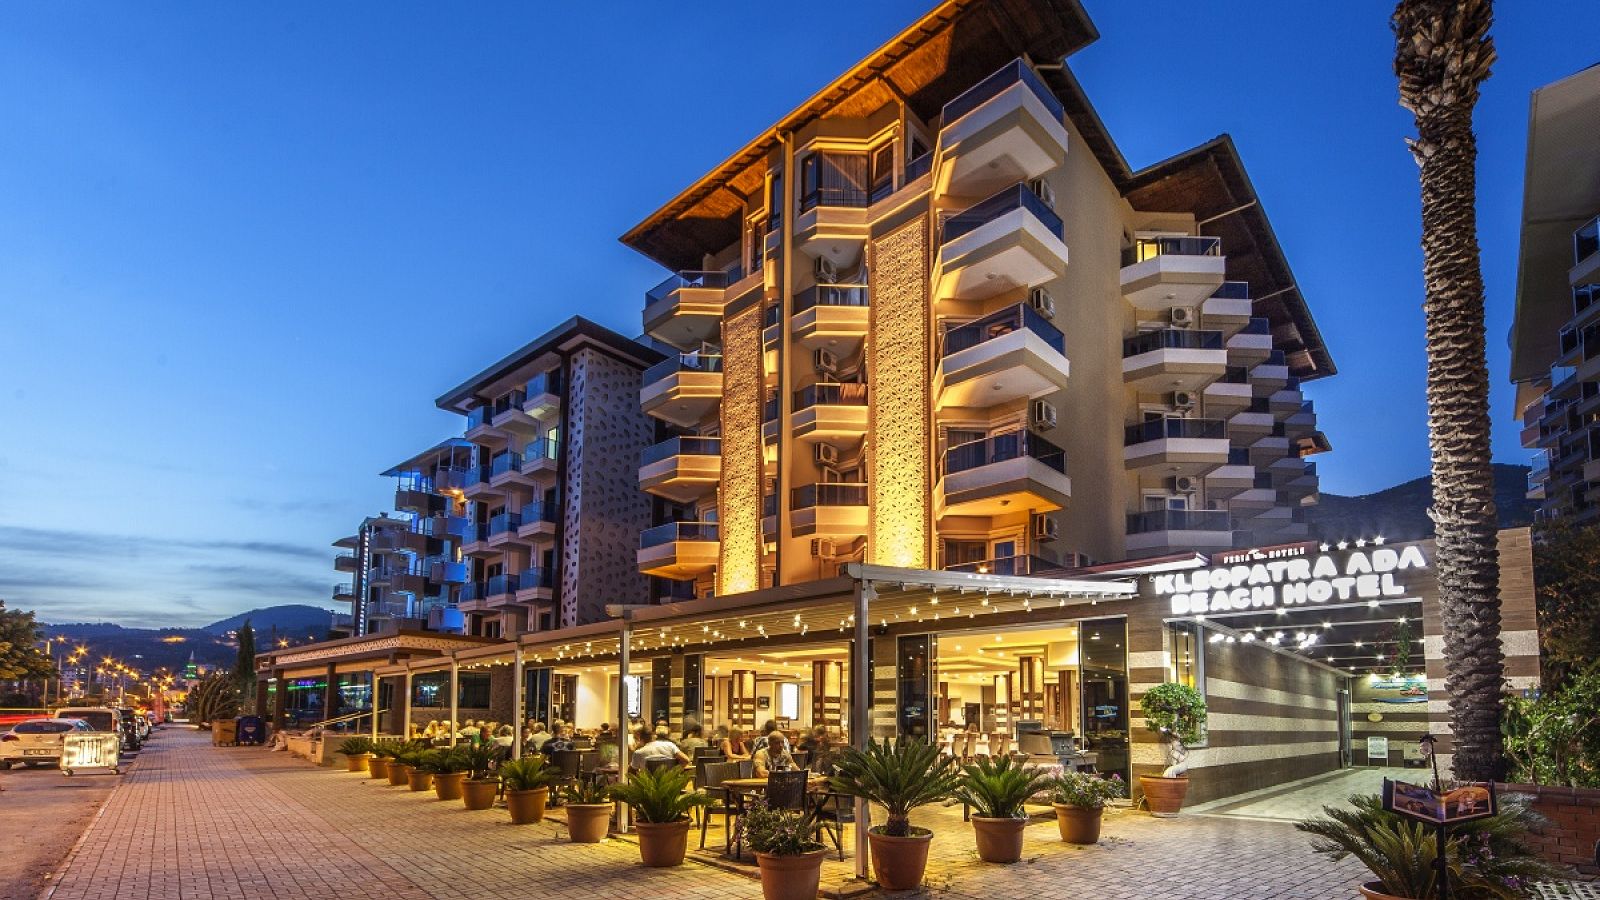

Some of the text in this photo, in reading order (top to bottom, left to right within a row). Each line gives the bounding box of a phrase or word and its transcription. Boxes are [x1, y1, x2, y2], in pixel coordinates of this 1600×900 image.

[1155, 545, 1426, 595] KLEOPATRA ADA
[1171, 573, 1405, 615] BEACH HOTEL
